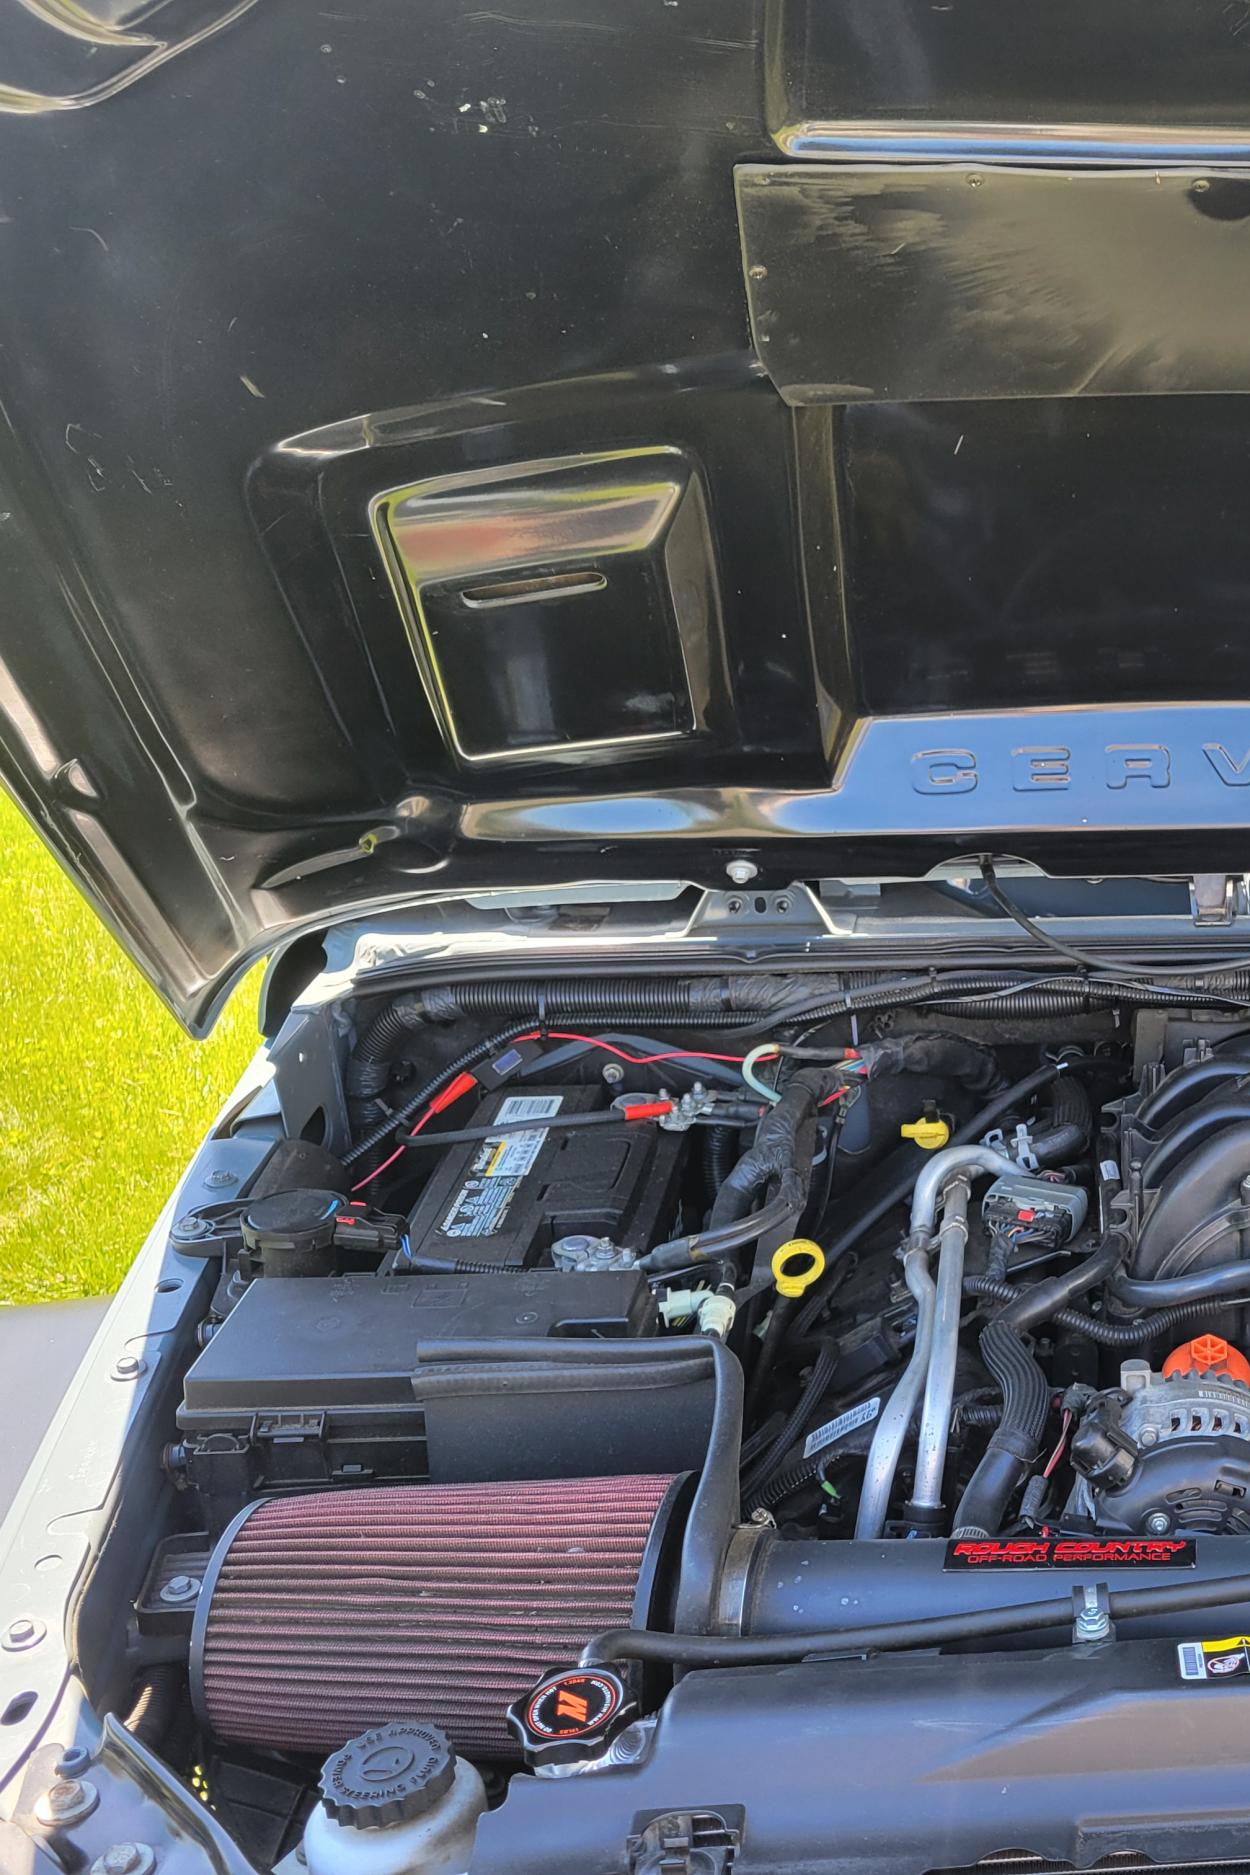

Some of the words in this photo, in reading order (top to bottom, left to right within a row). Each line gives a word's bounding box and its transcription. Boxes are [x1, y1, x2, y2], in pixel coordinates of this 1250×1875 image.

[953, 1542, 1050, 1556] ROUGH
[1054, 1541, 1187, 1553] COUNTRY
[967, 1554, 1047, 1564] OFF-ROAD
[1053, 1552, 1172, 1562] PERFORMANCE
